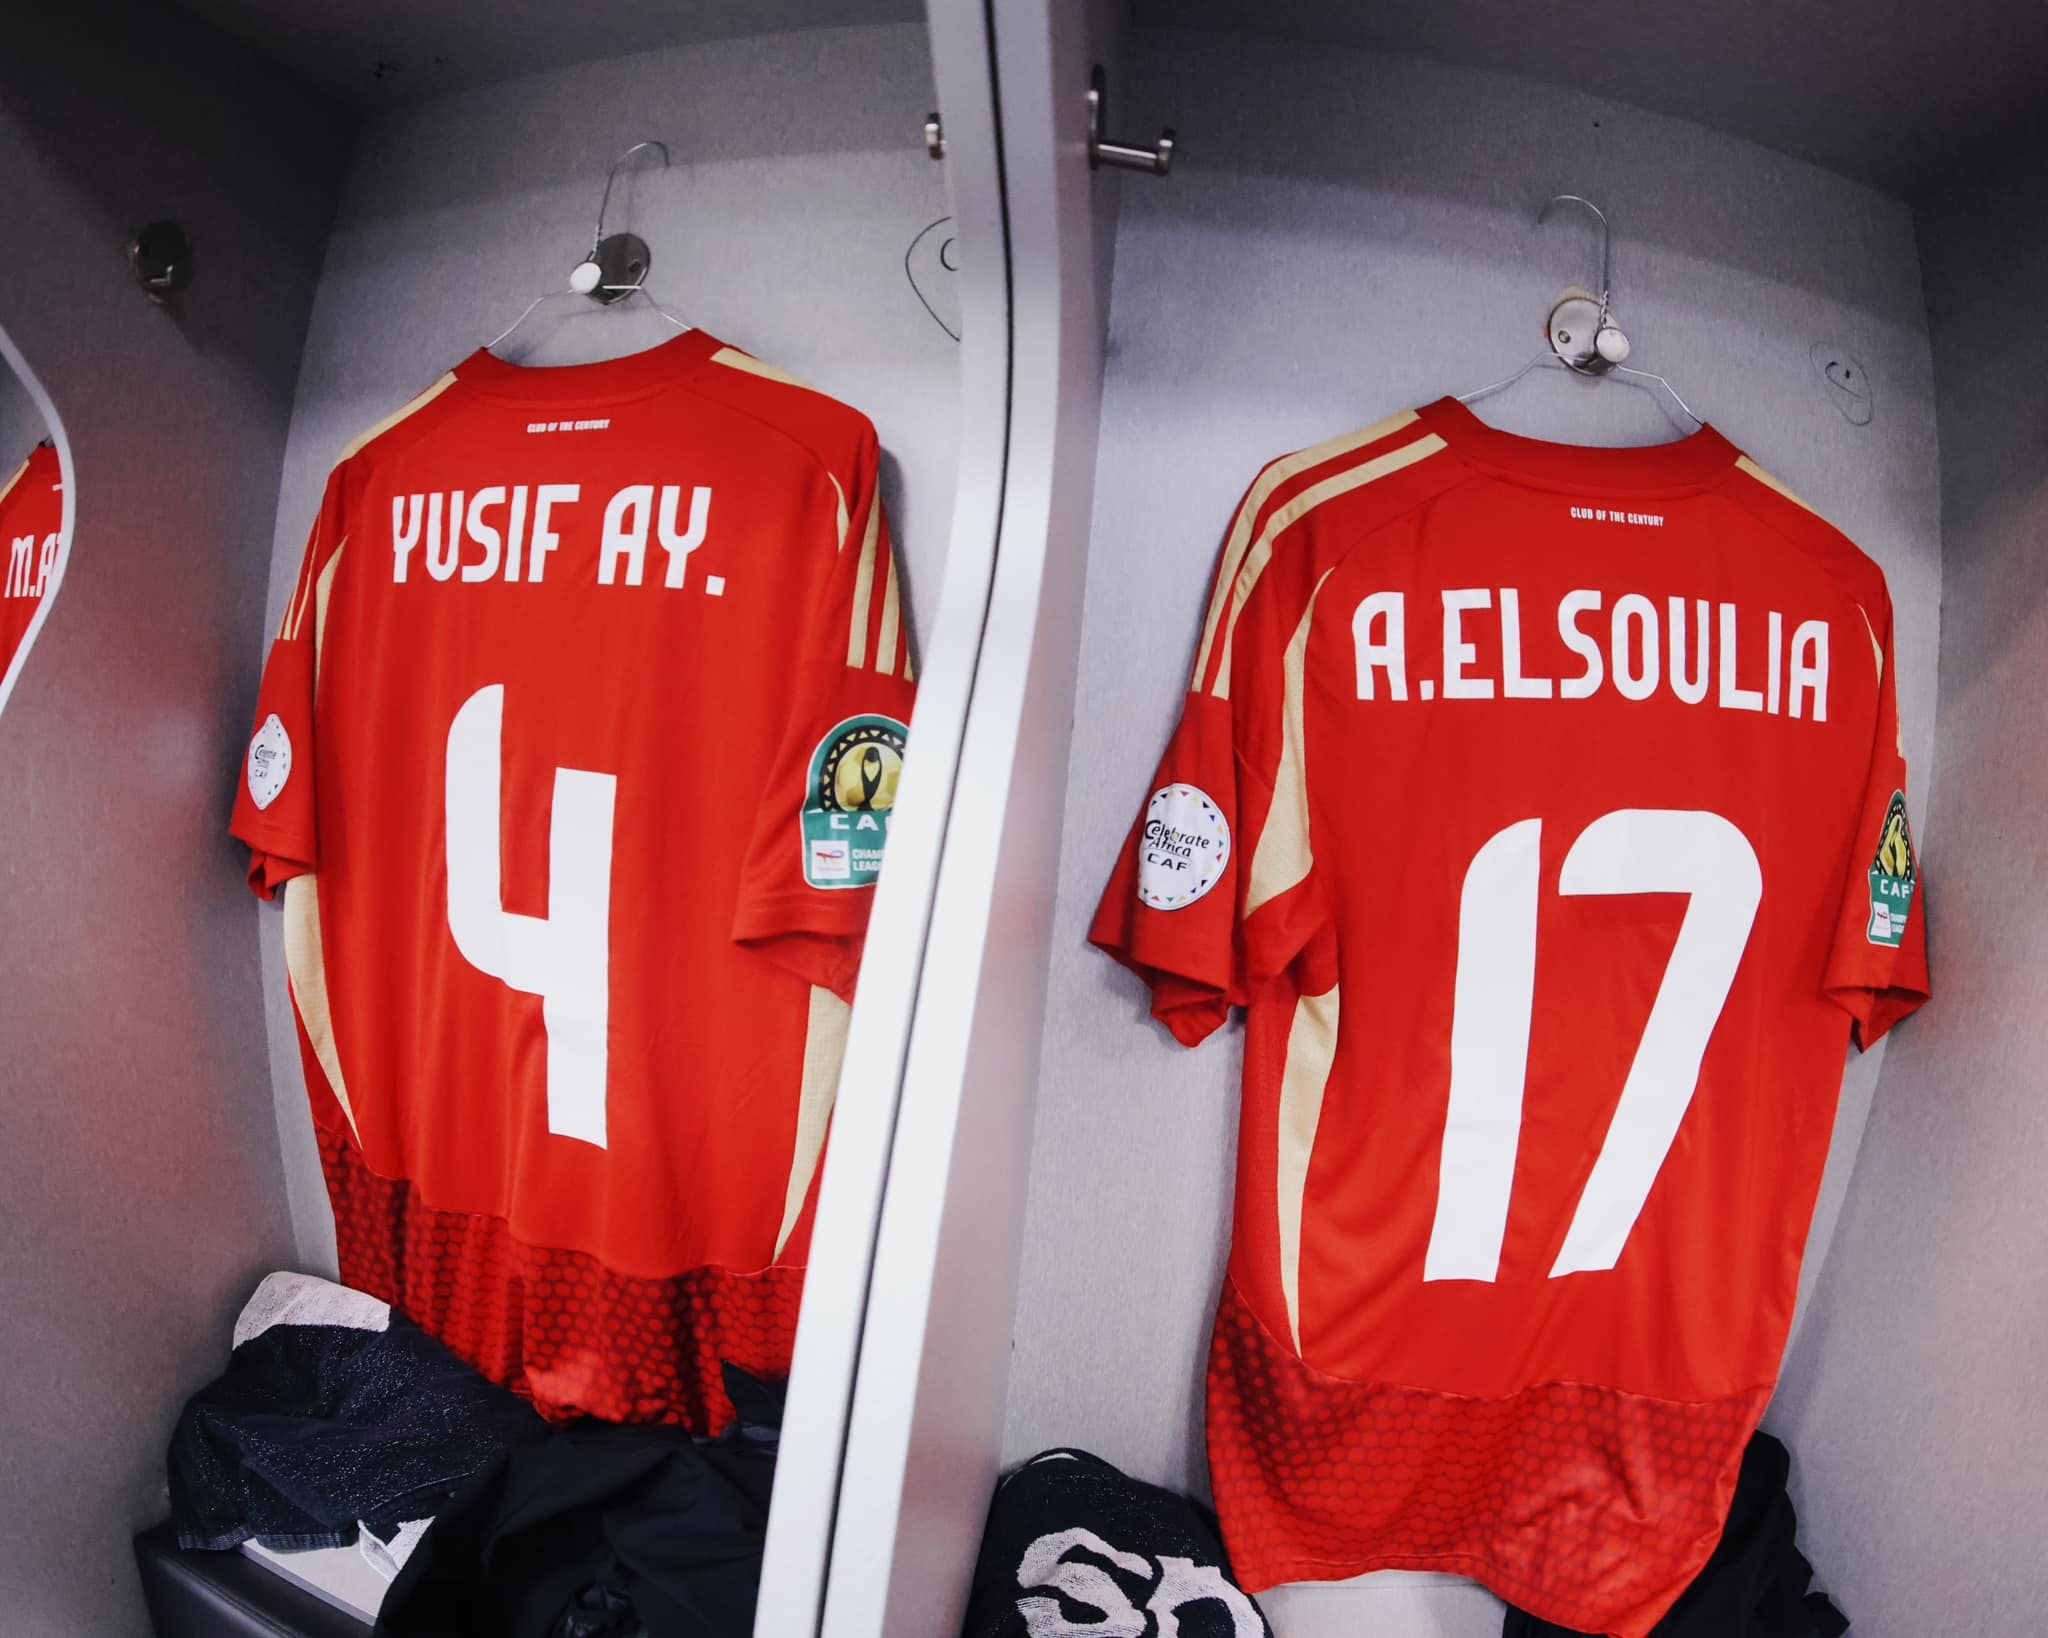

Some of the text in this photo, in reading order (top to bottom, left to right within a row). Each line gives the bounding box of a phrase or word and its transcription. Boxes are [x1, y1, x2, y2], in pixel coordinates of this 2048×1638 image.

[1570, 506, 1664, 527] CLUB OF THE CENTURY
[392, 484, 726, 597] YUSIF AY.
[1352, 588, 1829, 722] A.ELSOULIA
[1146, 820, 1210, 849] Celebrate
[1149, 837, 1192, 858] Africa
[1147, 853, 1187, 871] CAF
[1880, 878, 1910, 899] CAF
[445, 684, 617, 1150] 4
[1423, 808, 1763, 1283] 17
